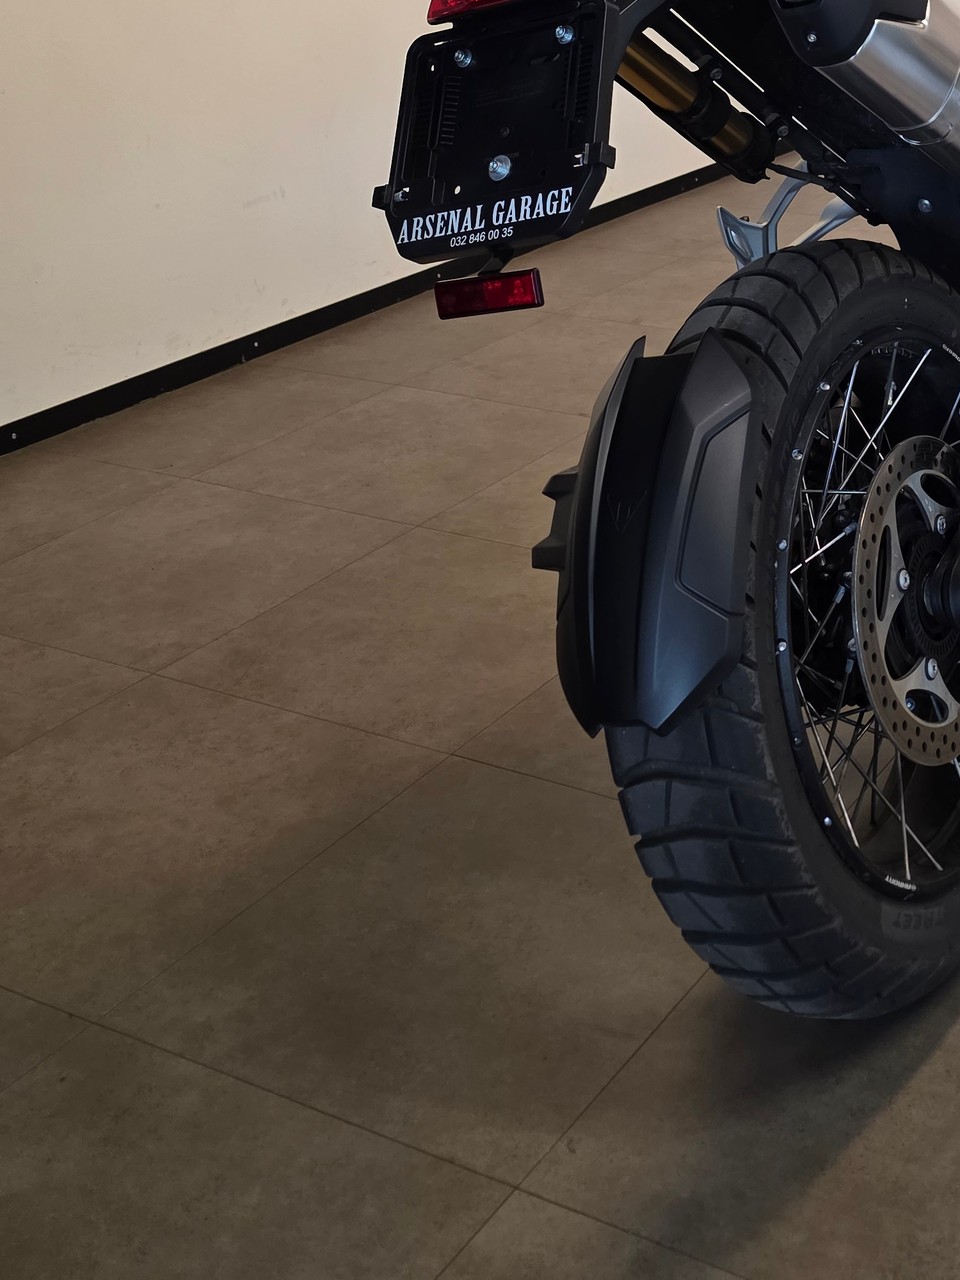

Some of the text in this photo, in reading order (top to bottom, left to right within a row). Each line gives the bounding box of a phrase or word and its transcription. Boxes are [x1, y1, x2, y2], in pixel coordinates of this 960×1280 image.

[397, 186, 573, 245] ARSENAL GARAGE
[450, 226, 514, 248] 032 846 00 35
